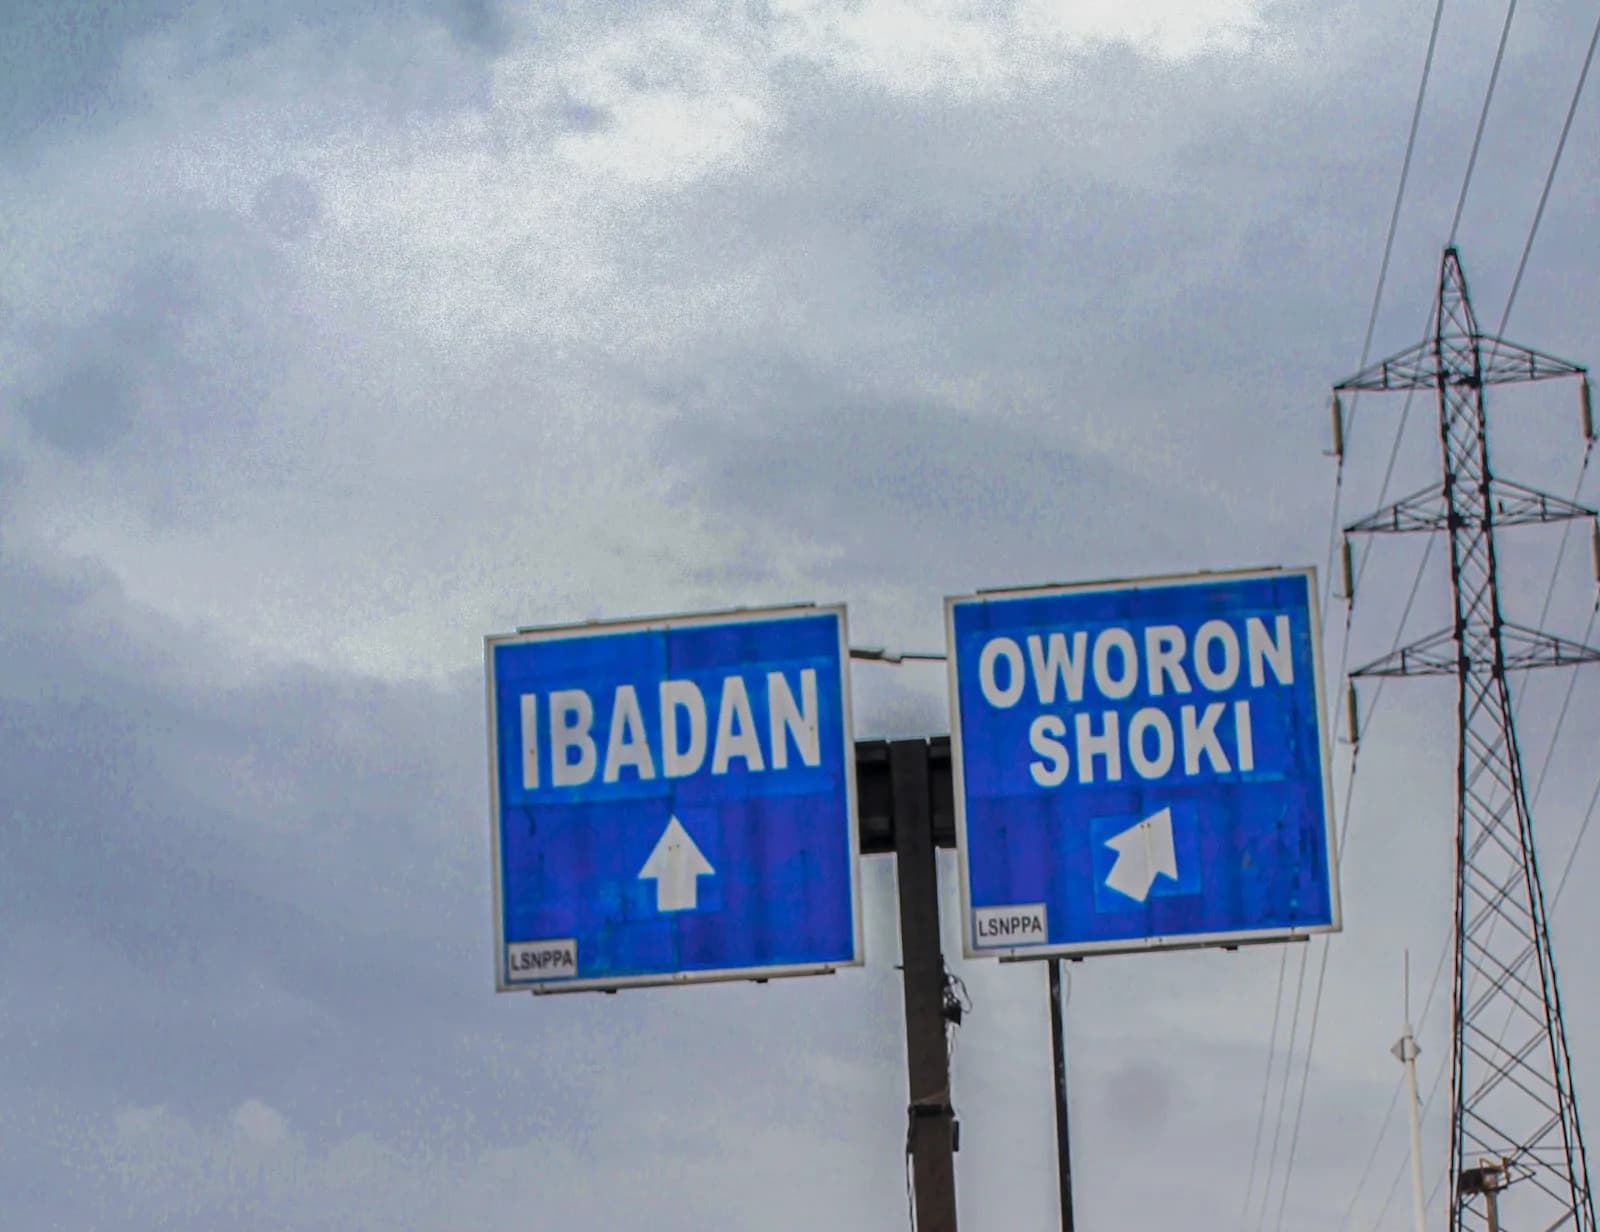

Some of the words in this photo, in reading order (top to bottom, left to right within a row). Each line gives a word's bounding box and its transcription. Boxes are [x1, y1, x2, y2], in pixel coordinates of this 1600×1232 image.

[979, 614, 1295, 709] OWORON
[520, 668, 822, 790] IBADAN
[1028, 699, 1255, 788] SHOKI
[510, 949, 574, 971] LSNPPA
[978, 915, 1042, 937] LSNPPA
